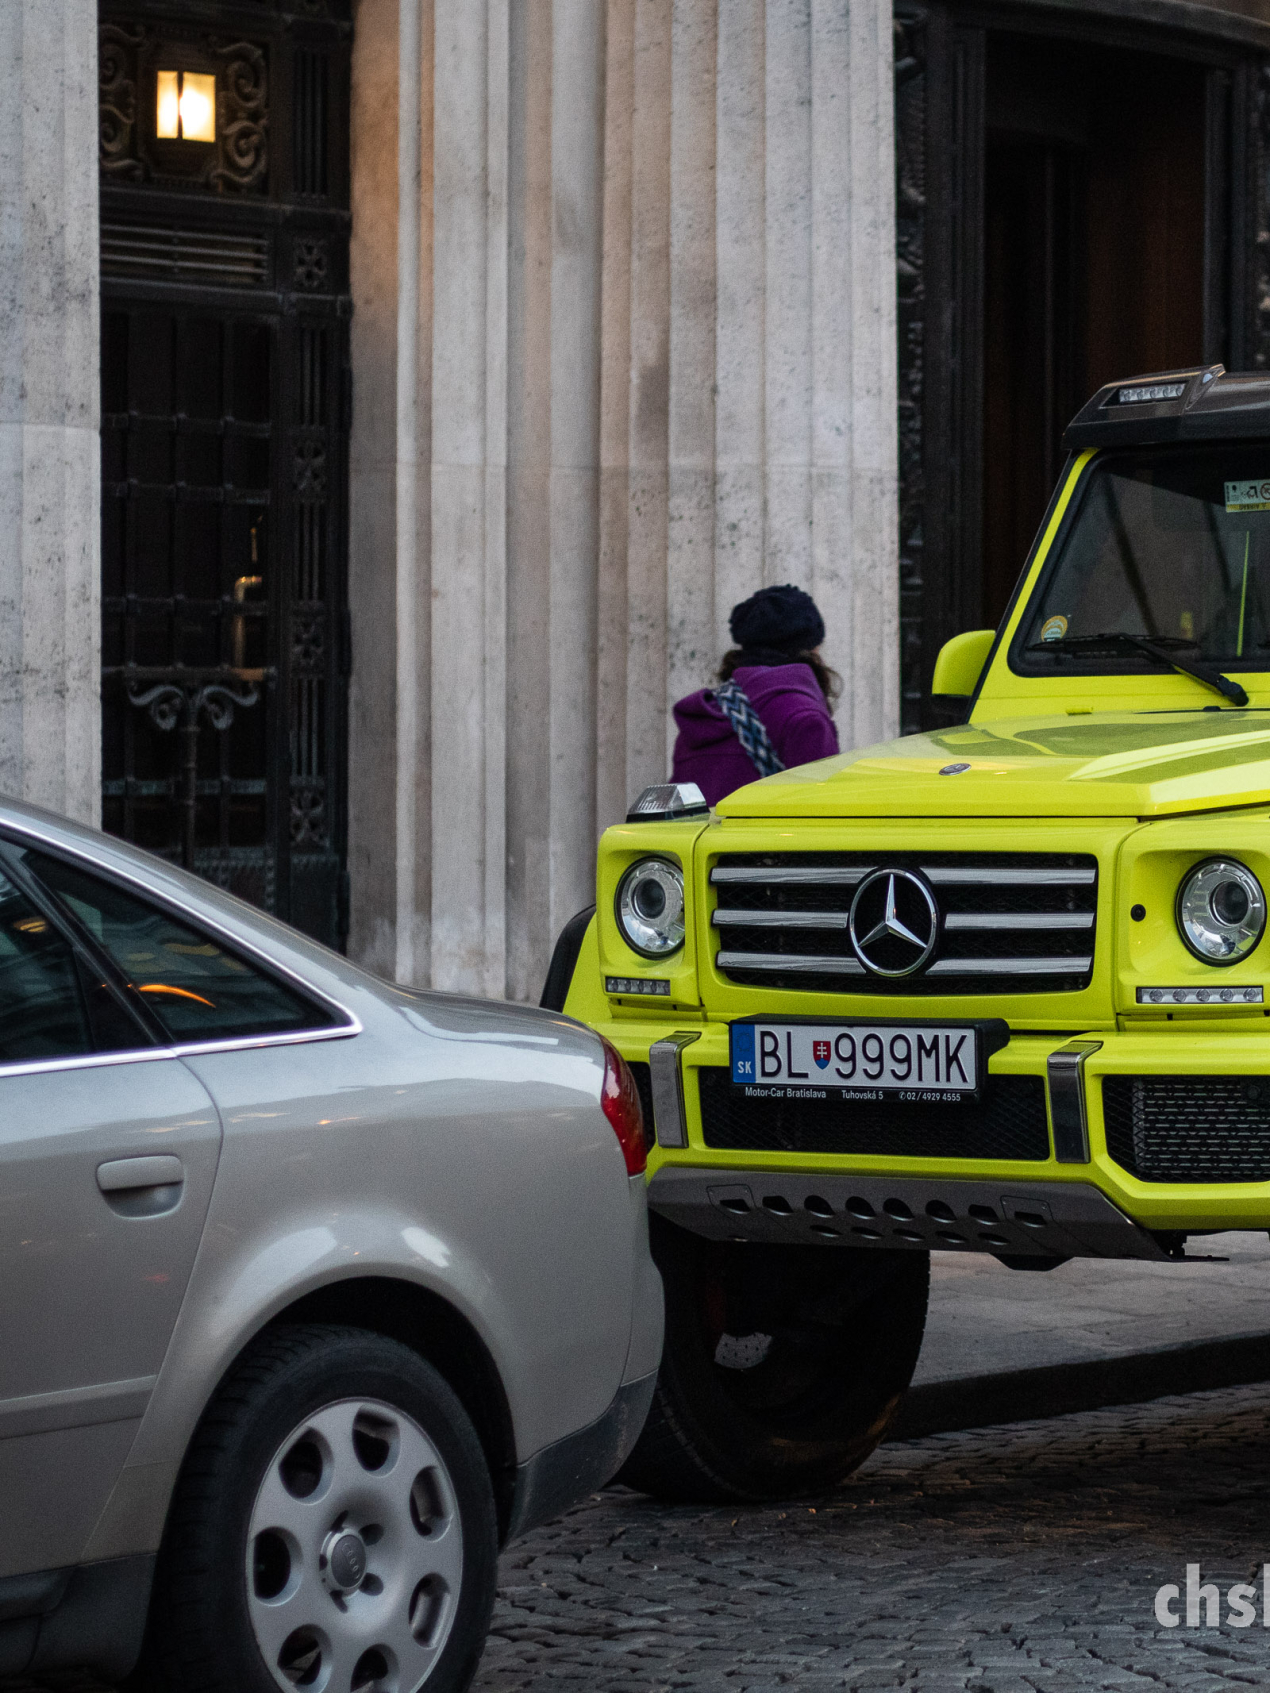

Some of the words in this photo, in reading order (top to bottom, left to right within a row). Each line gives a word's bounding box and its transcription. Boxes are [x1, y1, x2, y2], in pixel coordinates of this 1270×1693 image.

[760, 1030, 809, 1079] BL
[834, 1032, 968, 1083] 999MK
[737, 1061, 752, 1074] SK
[745, 1087, 785, 1098] Motor-Car
[786, 1088, 827, 1099] Bratislava
[841, 1090, 877, 1100] Tuhovská
[878, 1091, 884, 1100] 5
[942, 1093, 961, 1102] 4555
